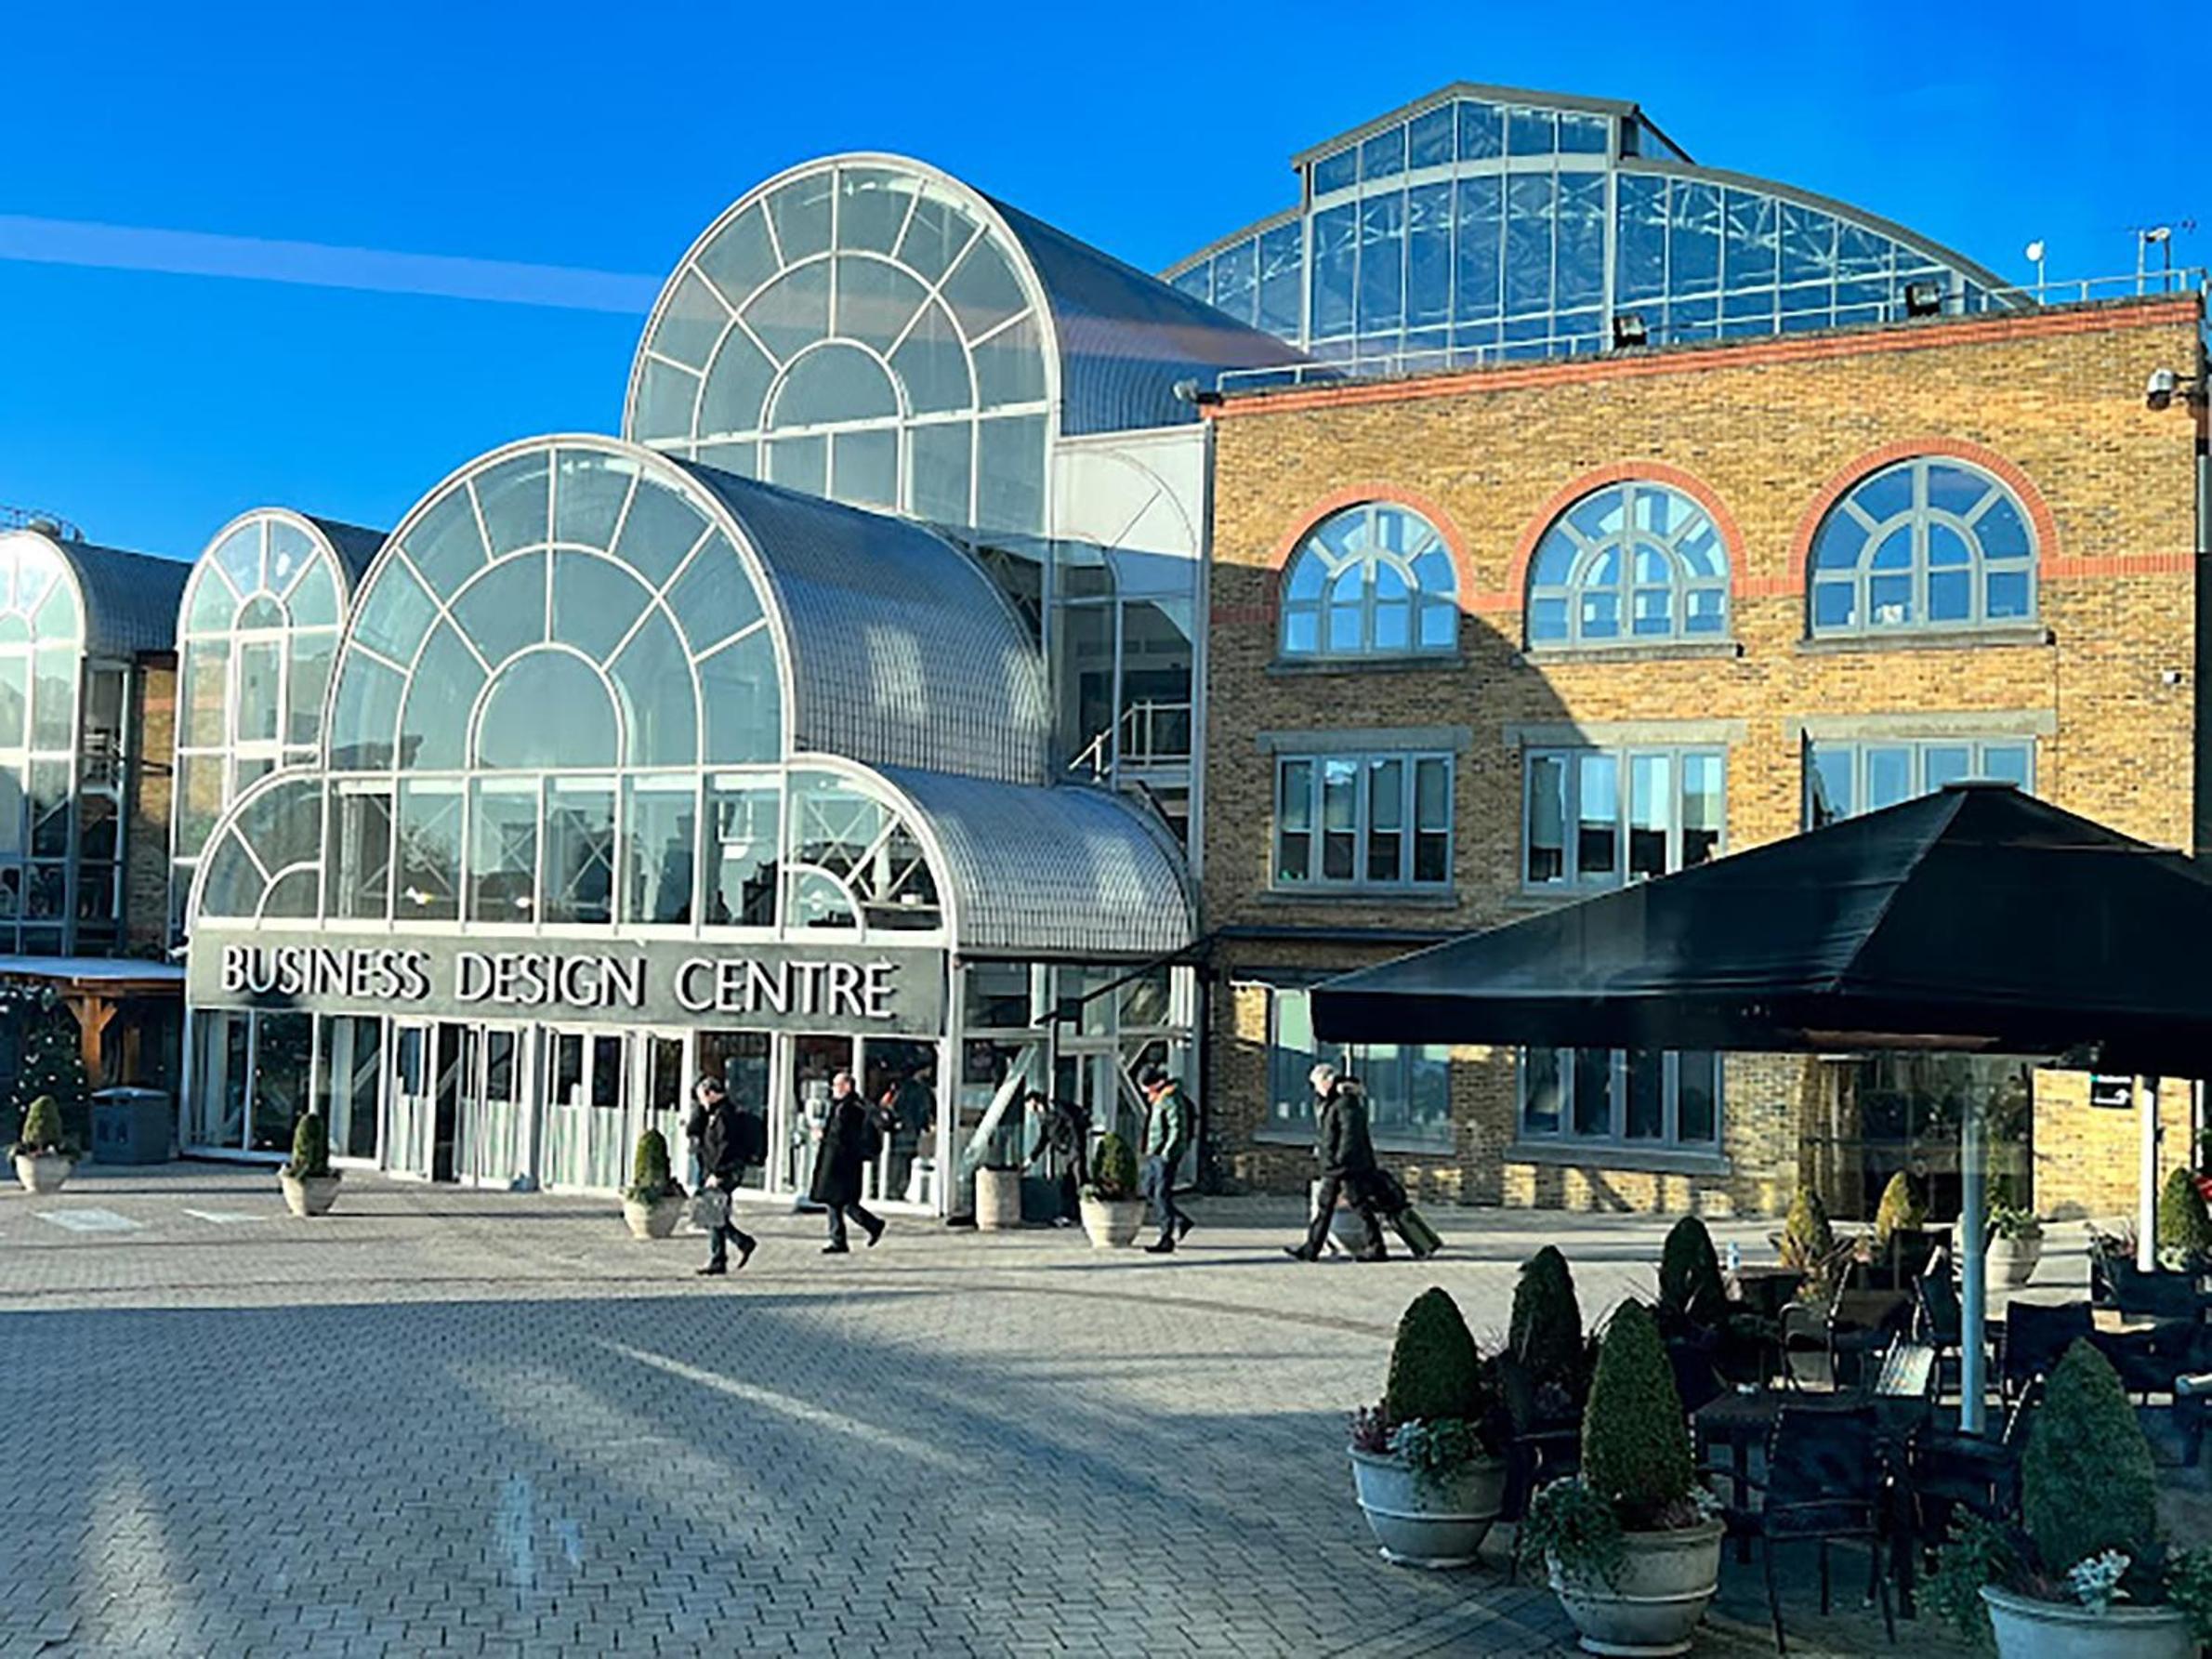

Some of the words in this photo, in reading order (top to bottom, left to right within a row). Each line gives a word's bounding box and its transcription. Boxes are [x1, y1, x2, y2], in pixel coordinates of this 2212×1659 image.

[221, 944, 429, 1000] BUSINESS
[454, 951, 646, 1007] DESIGN
[674, 957, 897, 1018] CENTRE
